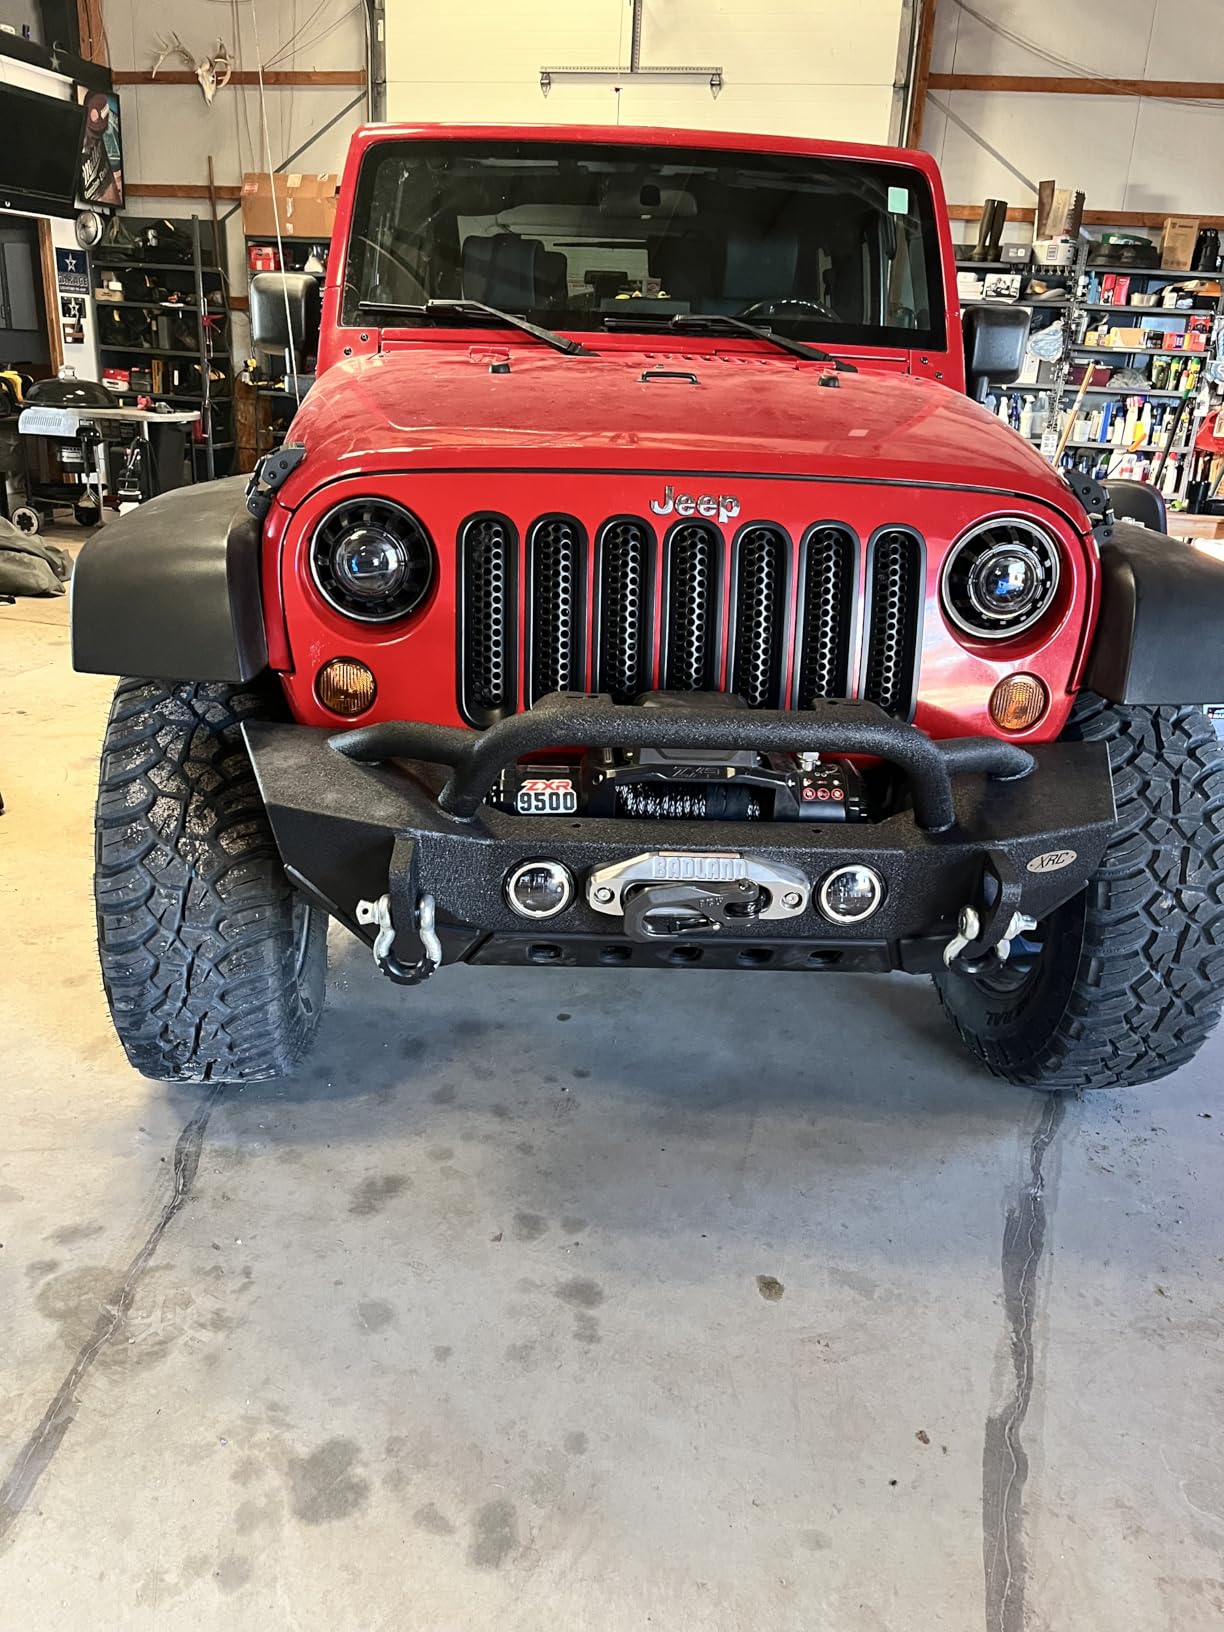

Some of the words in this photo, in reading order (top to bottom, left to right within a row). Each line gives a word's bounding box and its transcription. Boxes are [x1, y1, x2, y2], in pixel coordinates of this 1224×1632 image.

[650, 485, 740, 524] Jeep
[525, 780, 571, 791] ZXR
[519, 791, 576, 812] 9500
[652, 857, 748, 880] BADLAND
[1033, 852, 1070, 870] XRC
